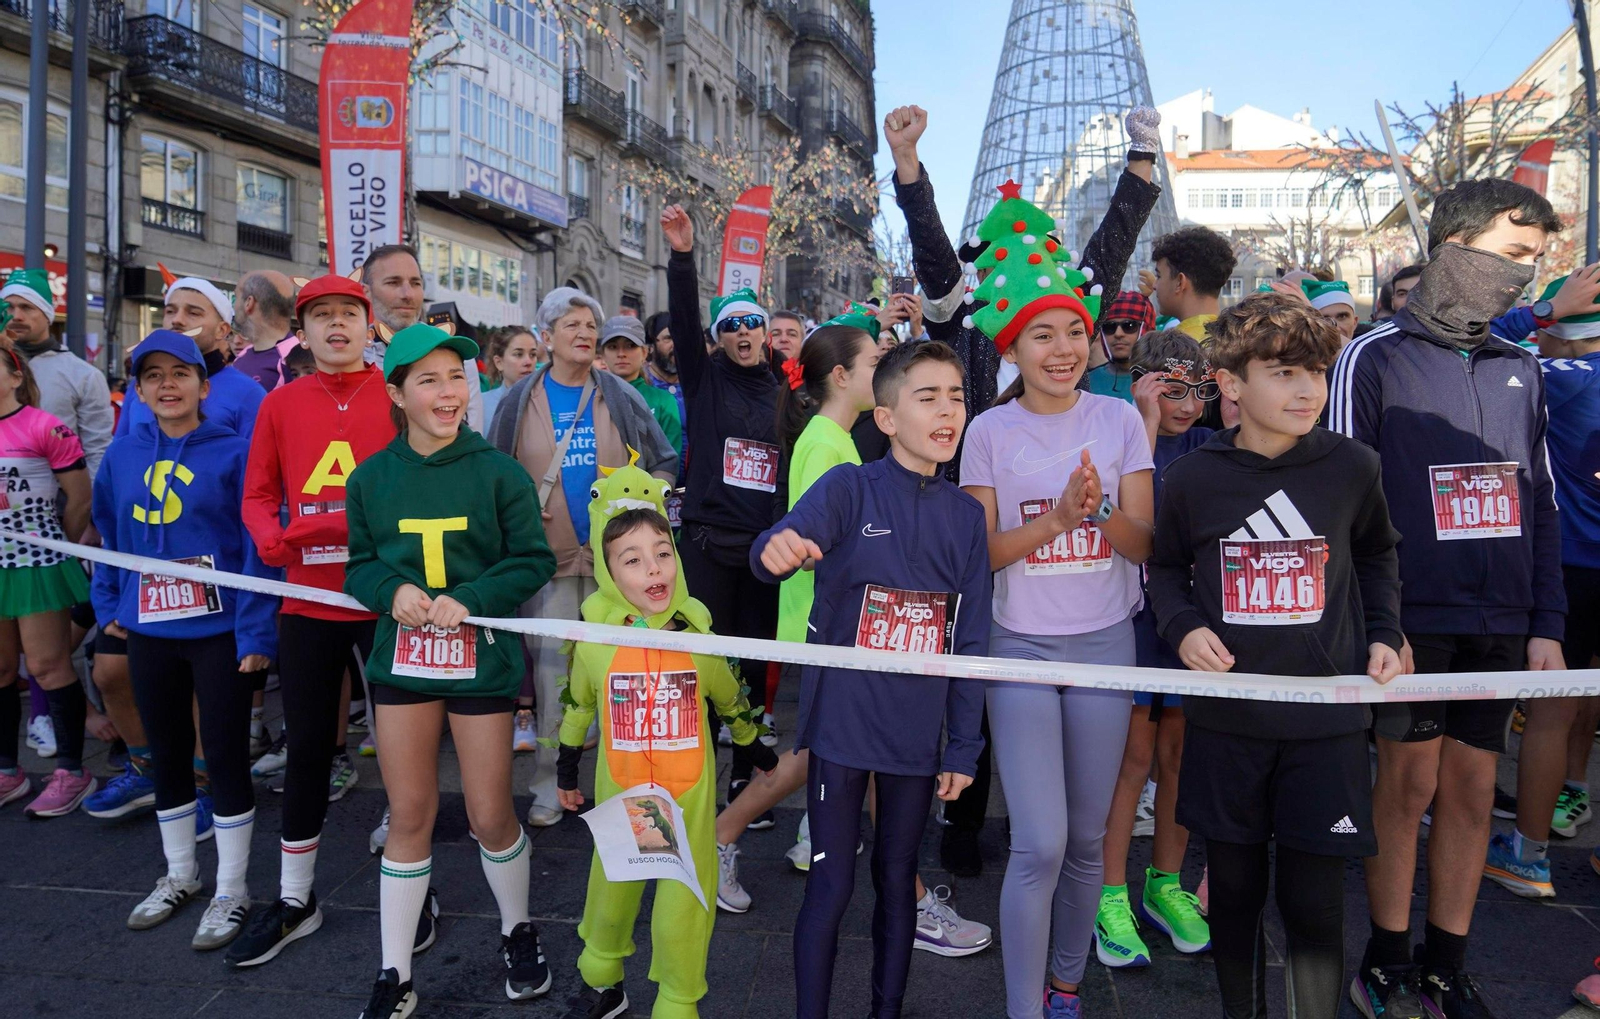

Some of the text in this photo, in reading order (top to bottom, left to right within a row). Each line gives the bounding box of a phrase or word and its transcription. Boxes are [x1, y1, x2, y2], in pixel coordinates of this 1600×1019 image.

[465, 160, 529, 211] PSICA
[369, 177, 386, 232] VIGO
[301, 440, 356, 495] A
[731, 458, 772, 481] 2657
[132, 460, 194, 525] S
[1461, 479, 1503, 493] vigo
[1450, 495, 1511, 526] 1949
[398, 516, 468, 589] T
[1249, 556, 1305, 574] vigo
[147, 582, 195, 611] 2109
[1236, 575, 1314, 609] 1446
[893, 605, 933, 623] vigo
[408, 636, 465, 666] 2108
[869, 619, 938, 654] 3468
[634, 706, 679, 738] 831
[628, 856, 655, 864] BUSCO
[1505, 863, 1535, 879] HOKA
